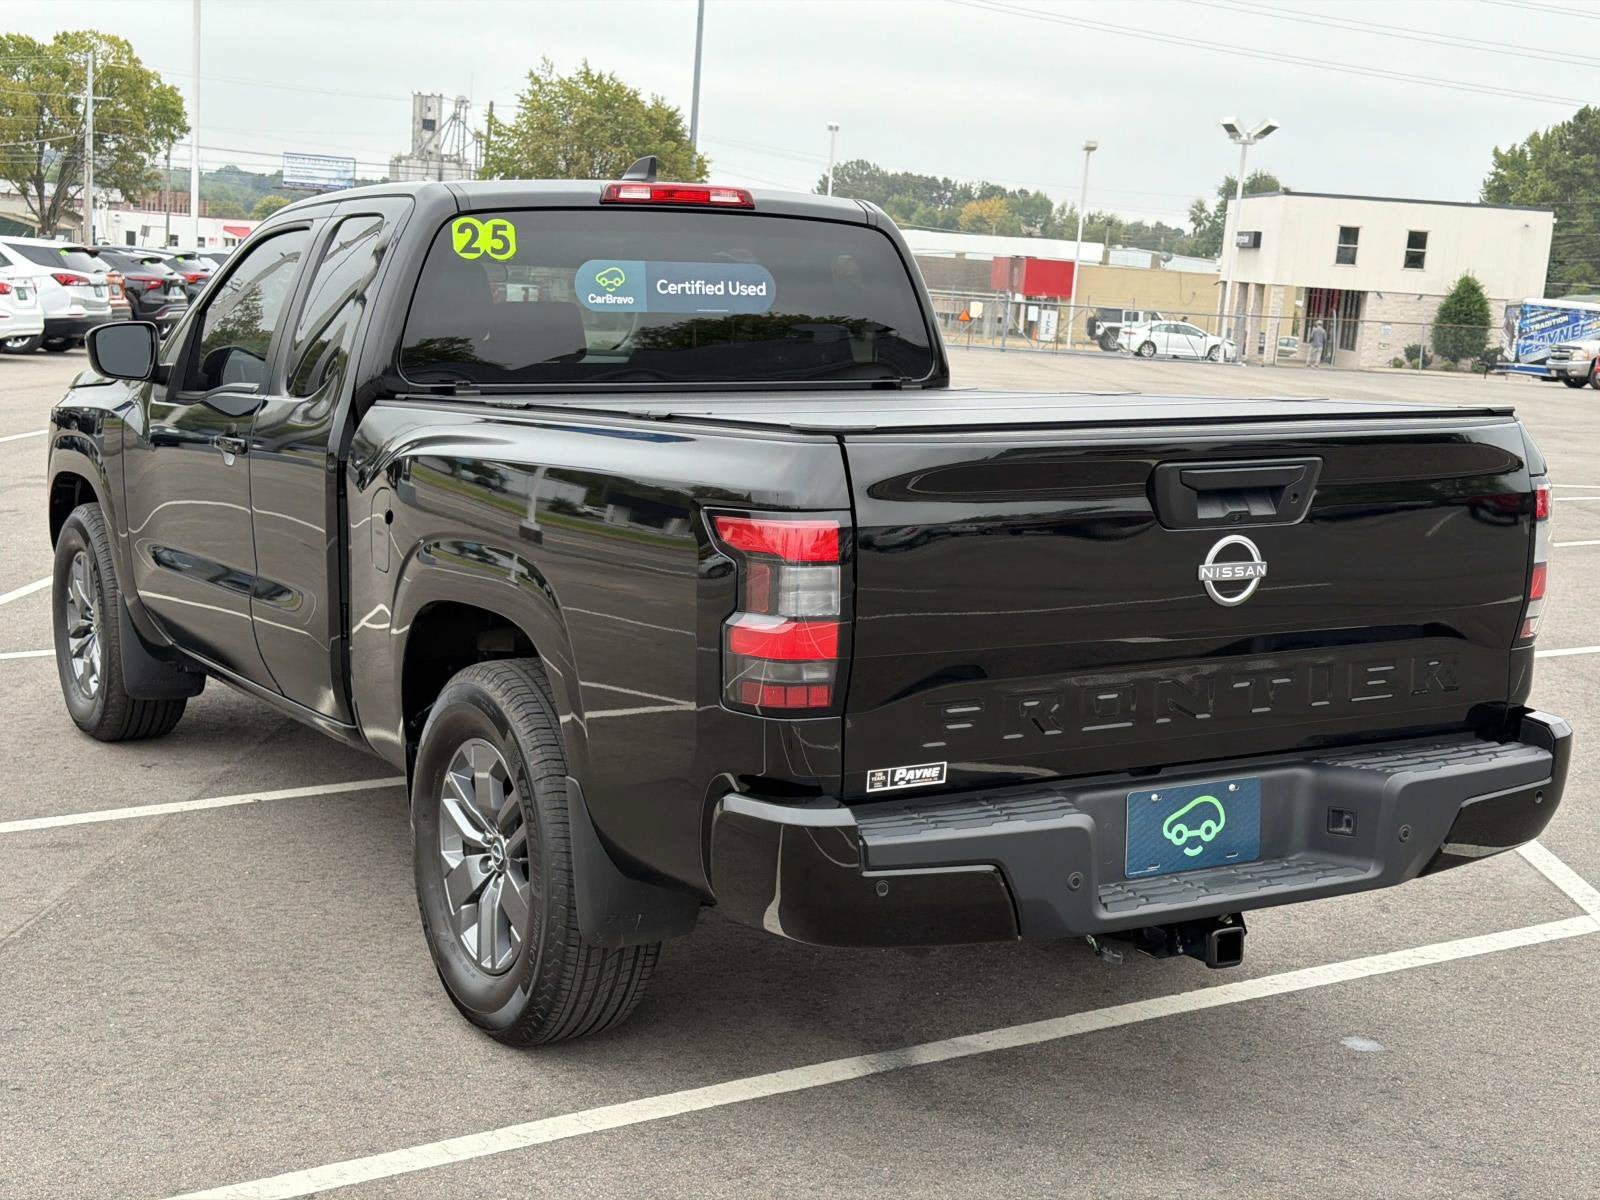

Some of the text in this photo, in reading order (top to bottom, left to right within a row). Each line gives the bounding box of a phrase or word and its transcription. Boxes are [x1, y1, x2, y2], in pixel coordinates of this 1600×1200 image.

[457, 222, 511, 256] 25
[656, 278, 767, 297] Certified Used
[588, 294, 634, 305] CarBravo
[1202, 565, 1266, 579] NISSAN
[922, 652, 1460, 748] FRONTIER
[894, 767, 941, 782] PAYNE
